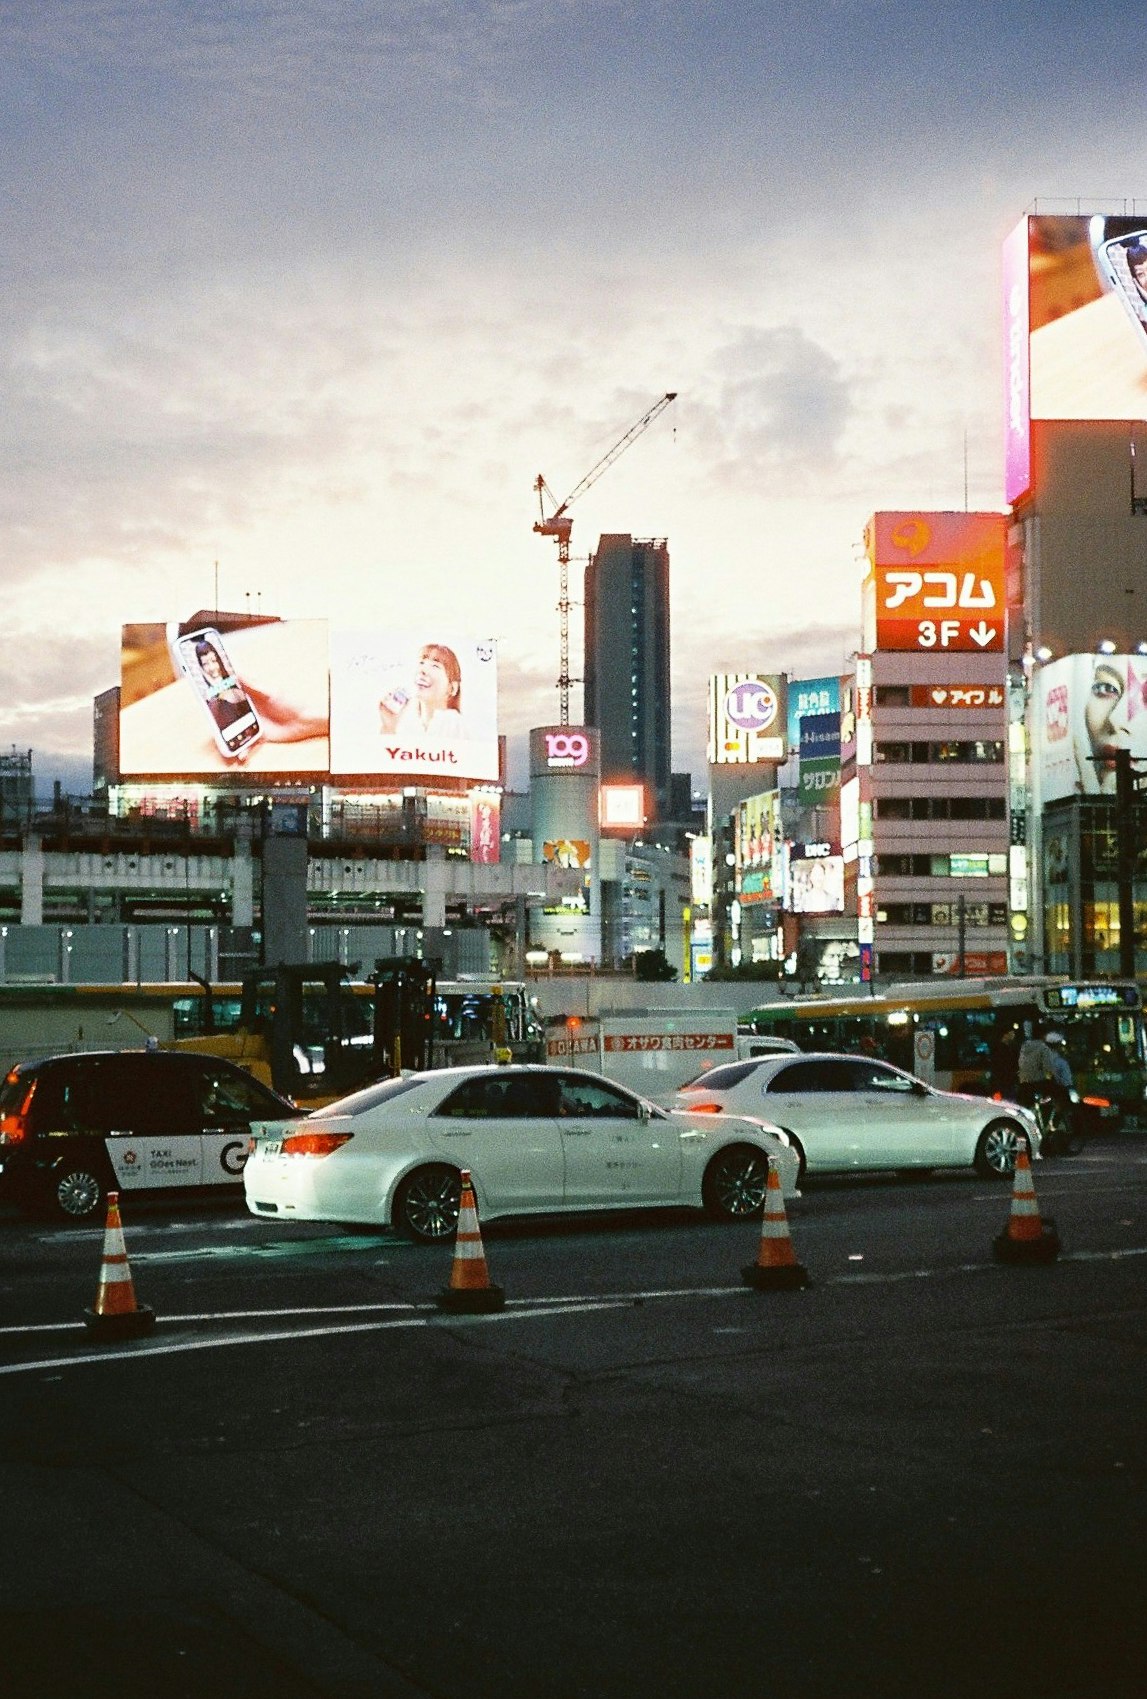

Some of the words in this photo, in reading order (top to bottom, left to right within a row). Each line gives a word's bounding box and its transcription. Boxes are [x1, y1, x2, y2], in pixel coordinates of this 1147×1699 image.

[885, 572, 996, 608] アコム
[918, 620, 960, 647] 3F
[950, 688, 1003, 705] アイフル
[385, 747, 458, 764] Yakult
[545, 734, 588, 766] 109
